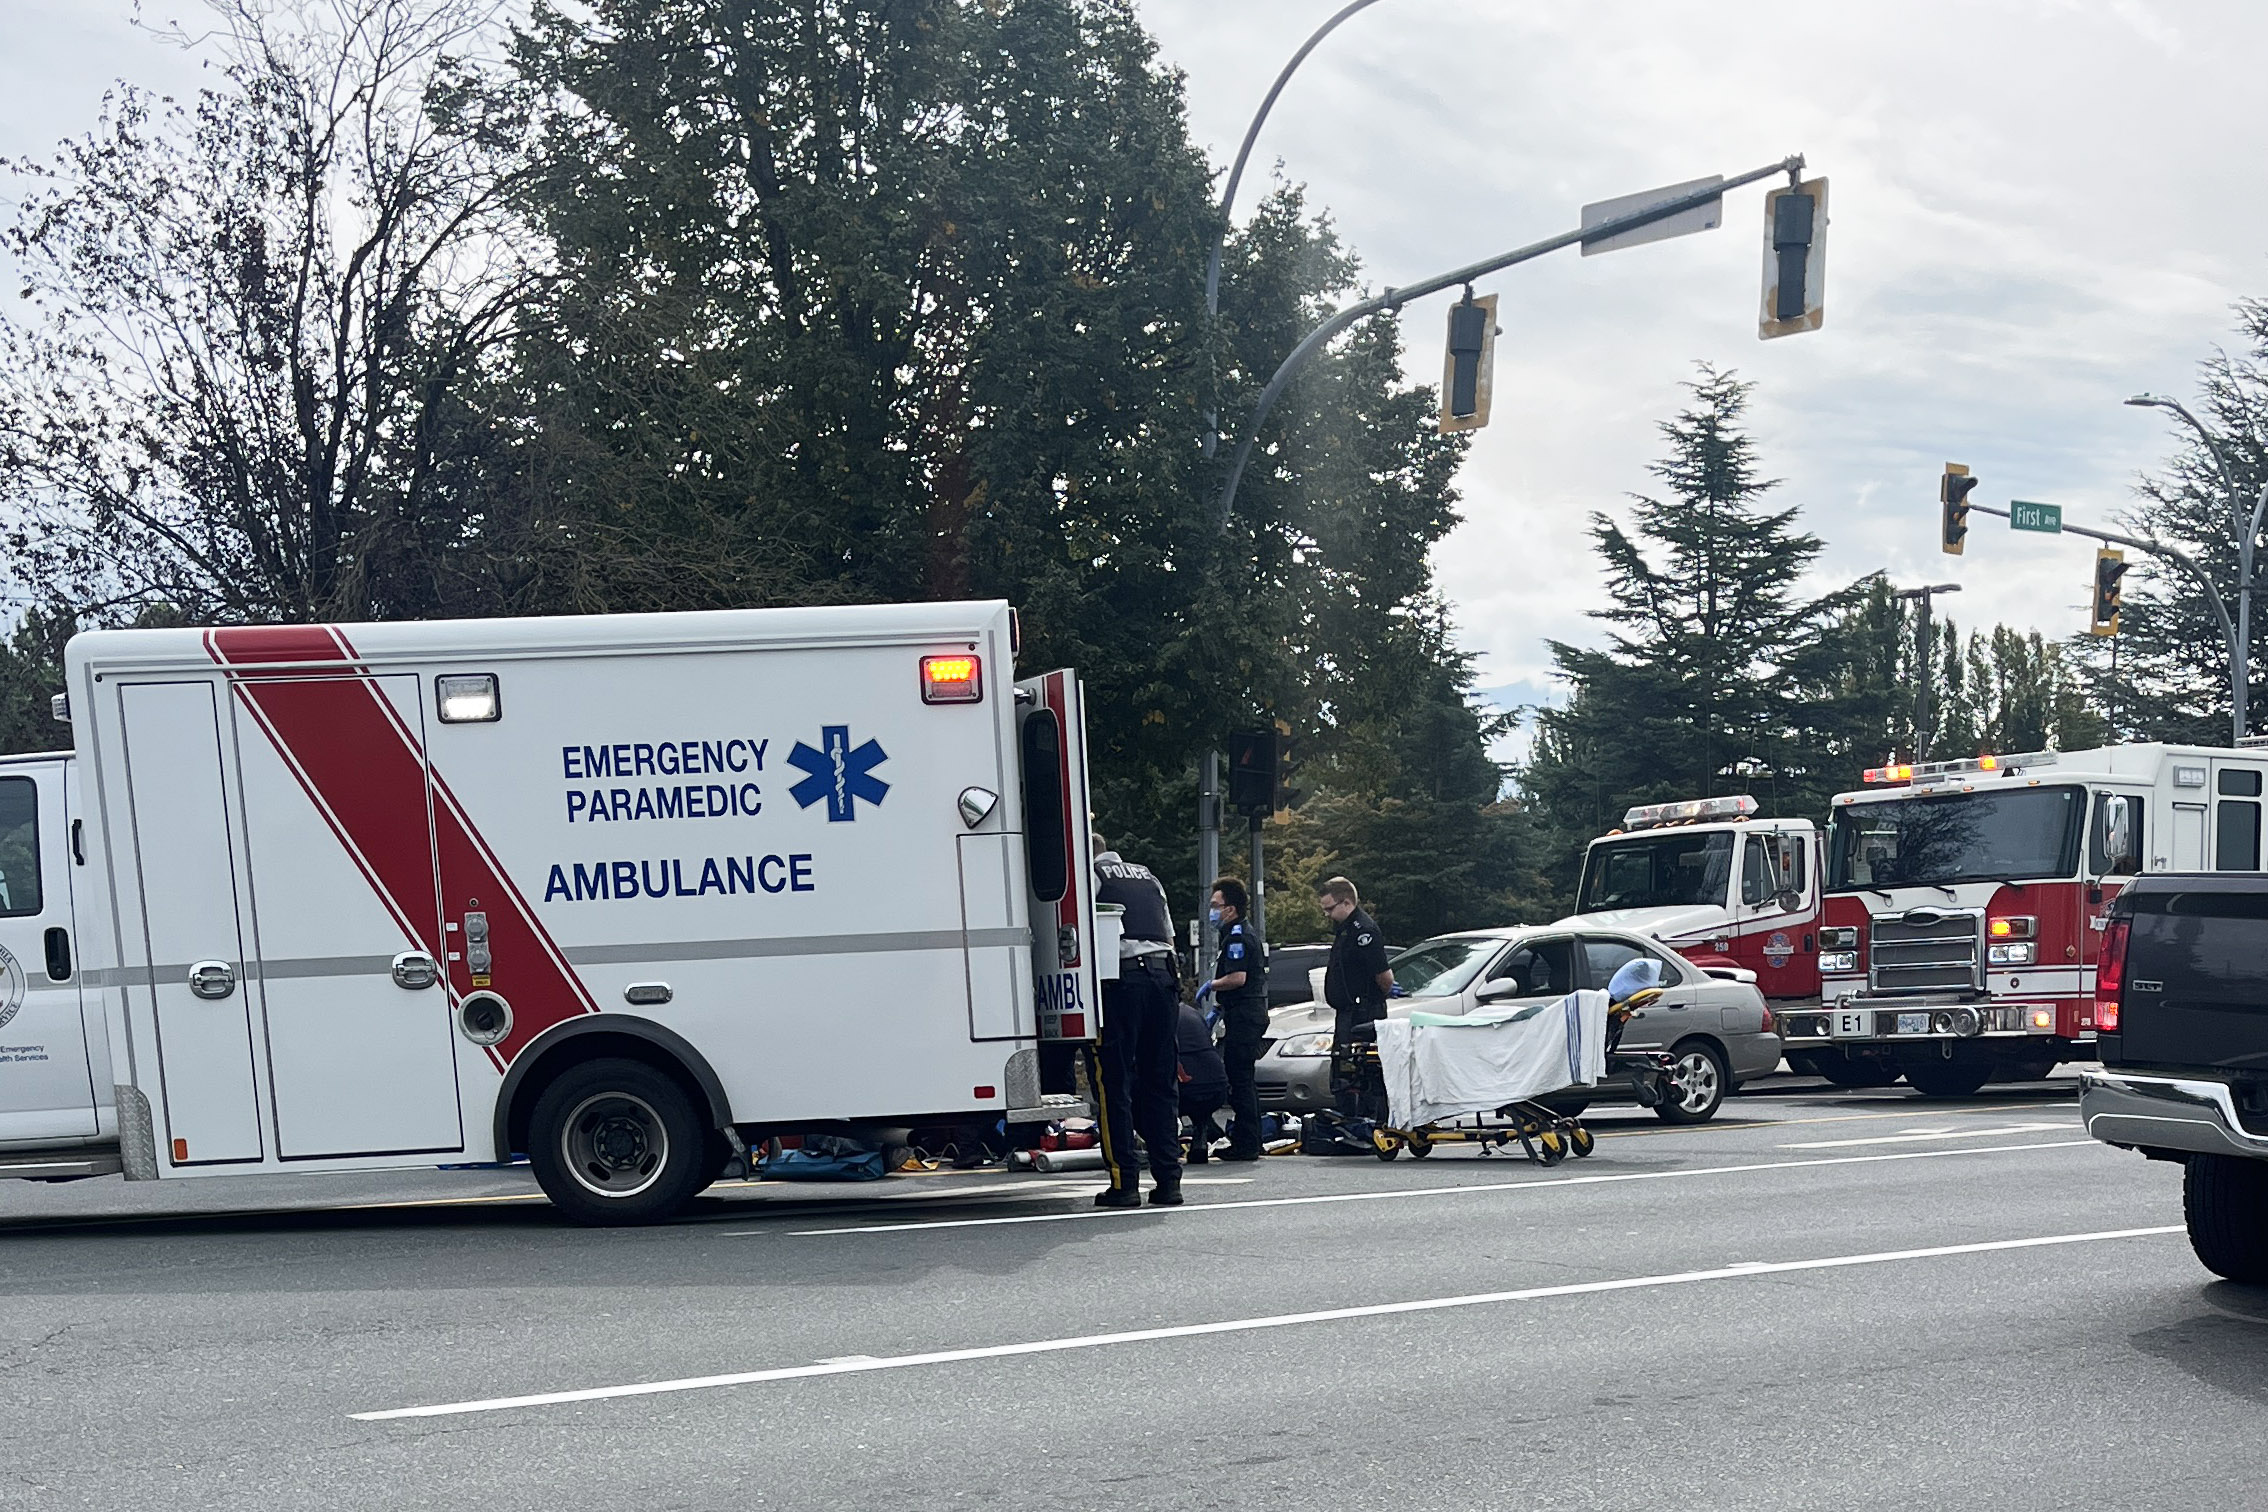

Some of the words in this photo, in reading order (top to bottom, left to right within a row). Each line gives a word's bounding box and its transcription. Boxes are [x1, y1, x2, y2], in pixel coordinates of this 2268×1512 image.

[2016, 505, 2040, 526] First
[563, 739, 769, 779] EMERGENCY
[566, 783, 762, 823] PARAMEDIC
[544, 853, 815, 902] AMBULANCE
[1101, 864, 1151, 880] POLICE
[1842, 1015, 1861, 1032] E1
[0, 1045, 44, 1054] Emergency
[14, 1054, 49, 1062] Services
